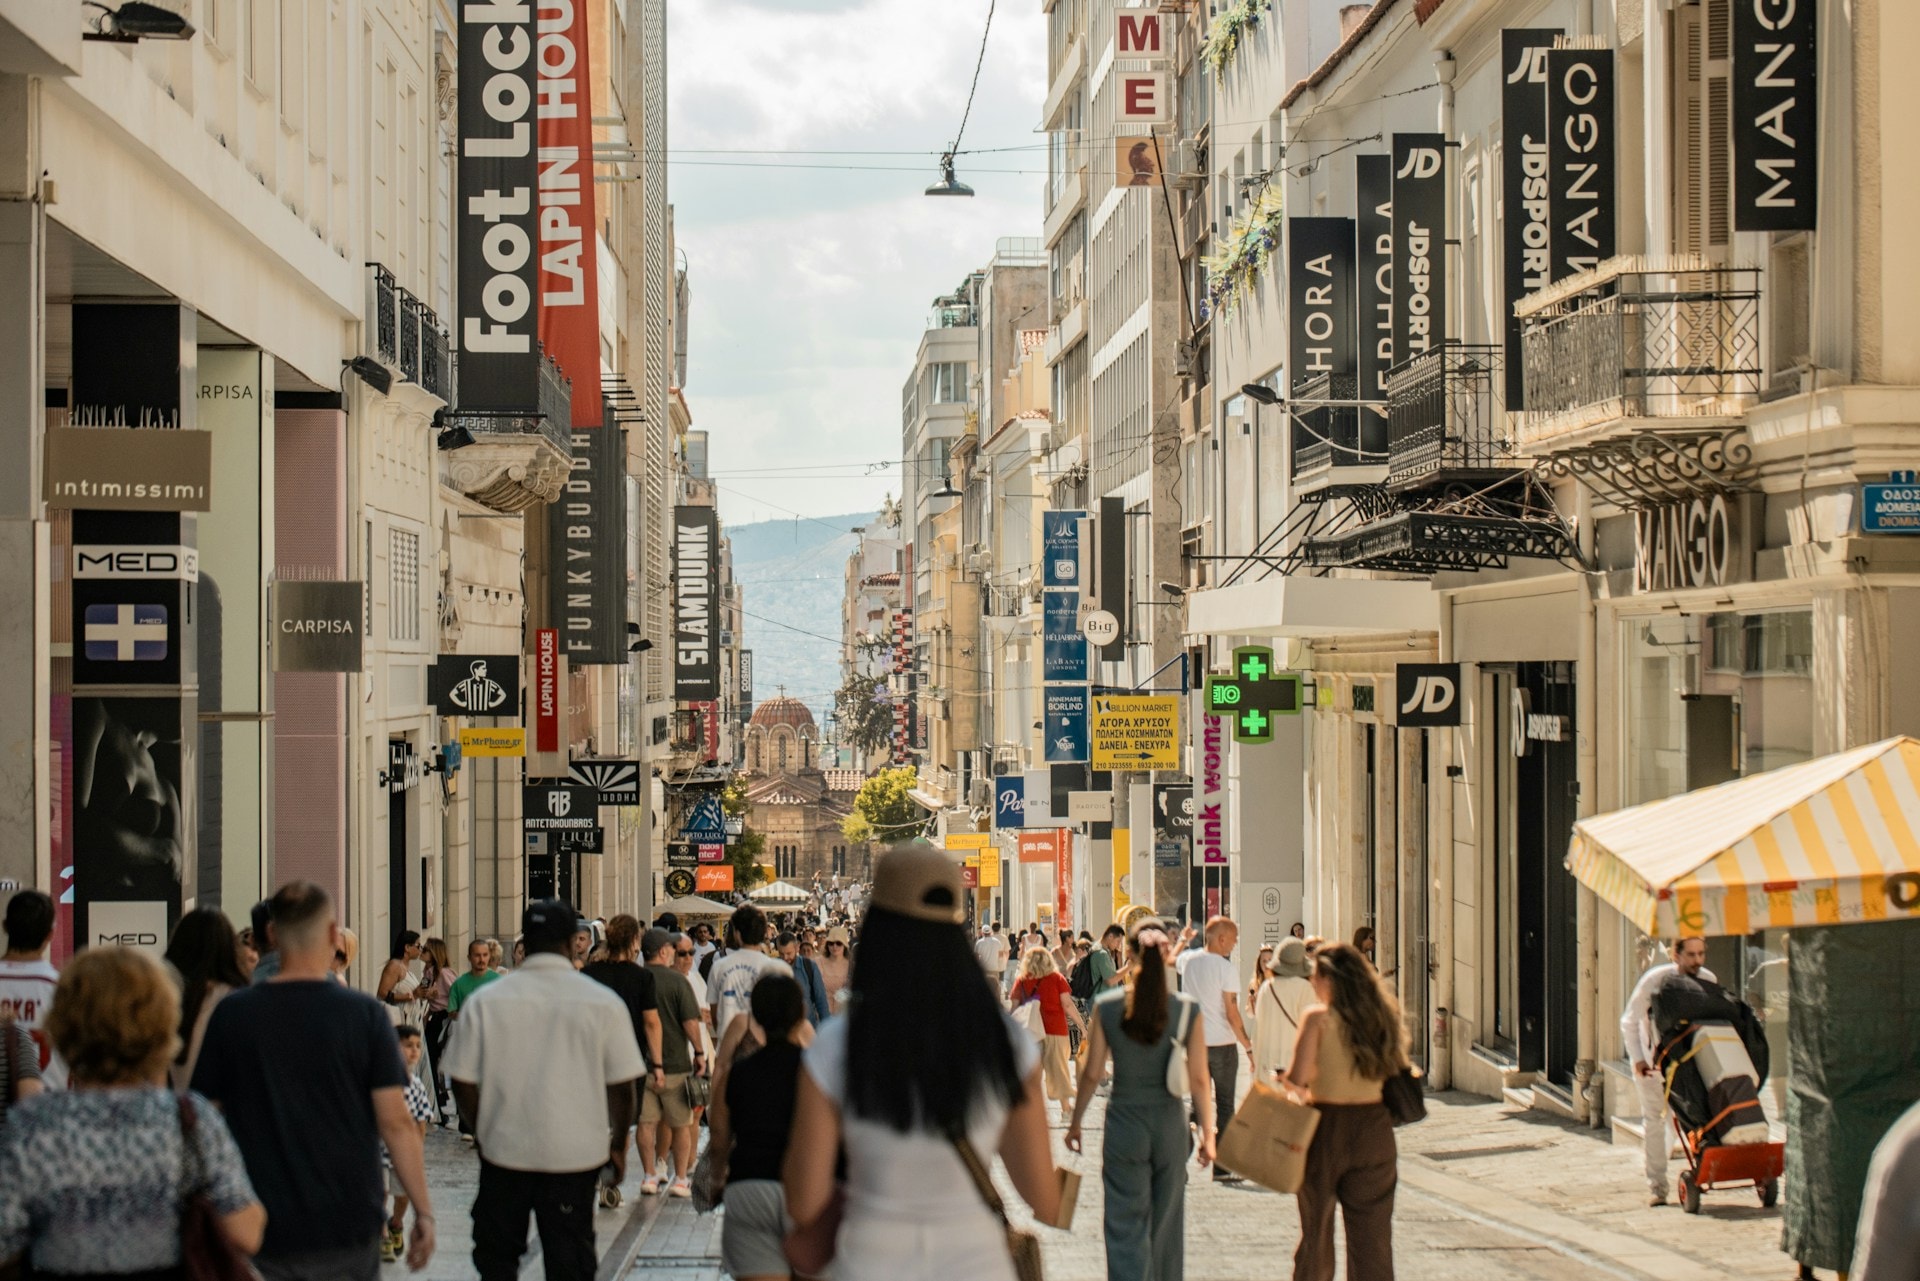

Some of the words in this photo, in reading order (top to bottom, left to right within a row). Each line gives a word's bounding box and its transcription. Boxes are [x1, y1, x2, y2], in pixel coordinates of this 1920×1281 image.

[1397, 147, 1442, 179] JD
[538, 146, 585, 307] LAPIN
[464, 185, 531, 353] Foot
[1900, 470, 1907, 483] 1
[55, 481, 205, 500] intimissimi
[78, 552, 178, 572] MED
[678, 524, 709, 667] SLAMDUNK
[281, 619, 354, 634] CARPISA
[1088, 620, 1112, 634] Big
[541, 631, 554, 675] HOUSE
[740, 652, 751, 692] COSMOS
[541, 677, 554, 716] LAPIN
[1401, 676, 1456, 714] JD
[1111, 704, 1141, 712] BILLION
[1142, 704, 1173, 712] MARKET
[1099, 718, 1131, 727] ΑΓΟΡΑ
[1133, 718, 1171, 727] ΧΡΥΣΟΥ
[471, 737, 522, 747] MrPhone.gr
[1095, 729, 1124, 739] ΠΩΛΗΣΗ
[1125, 729, 1173, 739] ΚΟΣΜΗΜΑΤΩΝ
[1099, 740, 1128, 750] ΔΑΝΕΙΑ
[1134, 740, 1171, 750] ΕΝΕΧΥΡΑ
[1196, 803, 1228, 864] pink
[99, 932, 157, 946] MED
